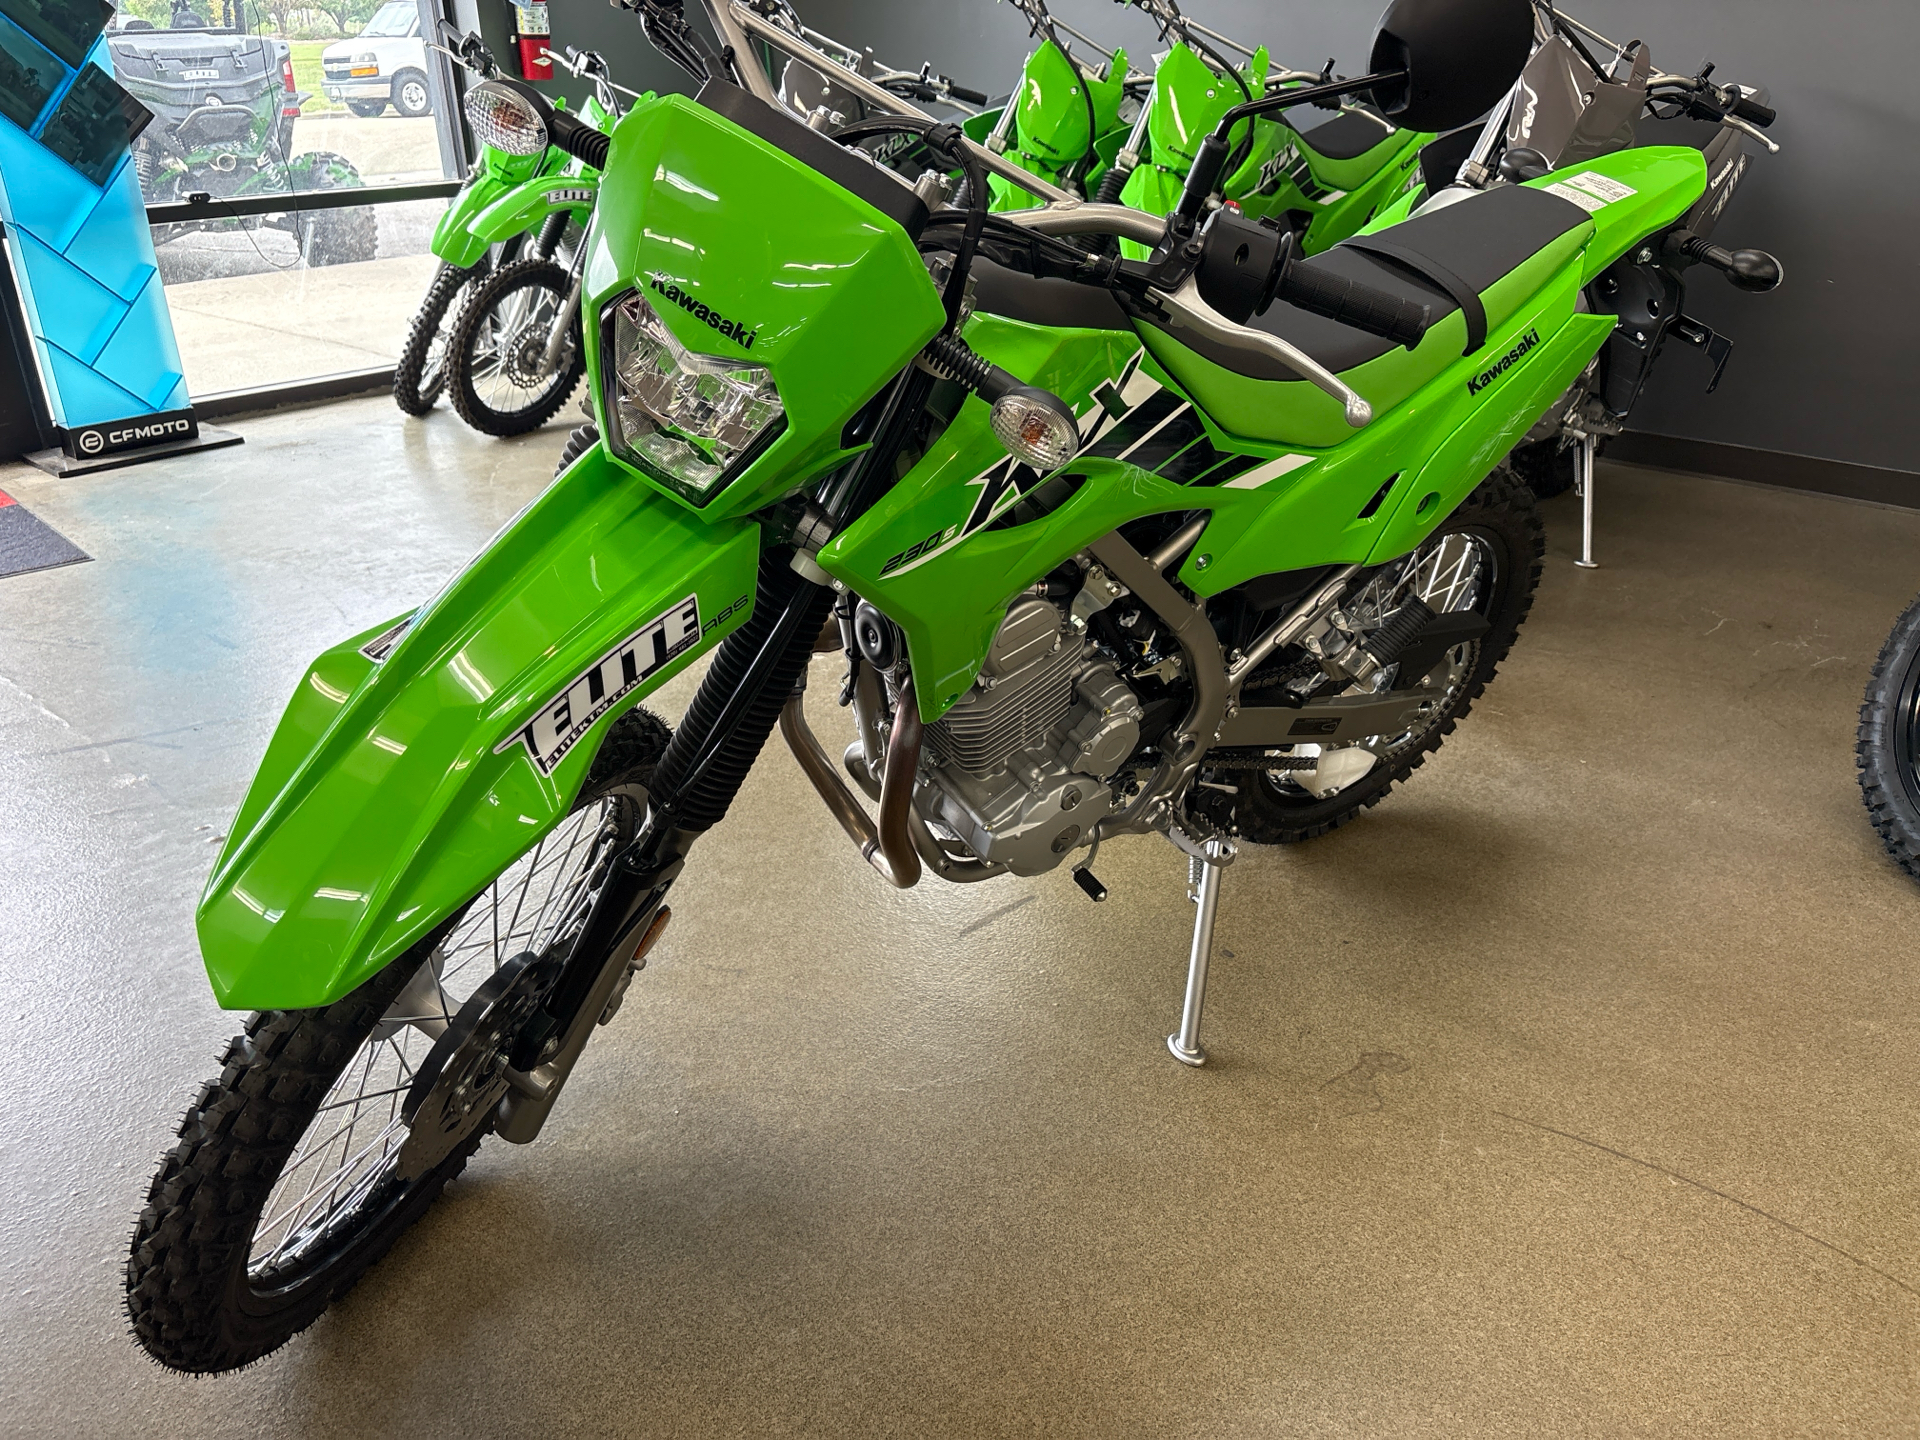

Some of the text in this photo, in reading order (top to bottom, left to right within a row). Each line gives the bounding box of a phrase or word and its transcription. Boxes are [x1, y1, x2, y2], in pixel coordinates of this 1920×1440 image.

[1256, 137, 1296, 188] KLX
[1710, 158, 1733, 190] Kawasaki
[549, 190, 592, 204] ELITE
[1467, 327, 1541, 396] Kawasaki
[109, 419, 189, 444] CFMOTO
[702, 594, 748, 636] ABS
[531, 598, 699, 769] ELITE
[546, 674, 643, 770] ELITEKTM.COM
